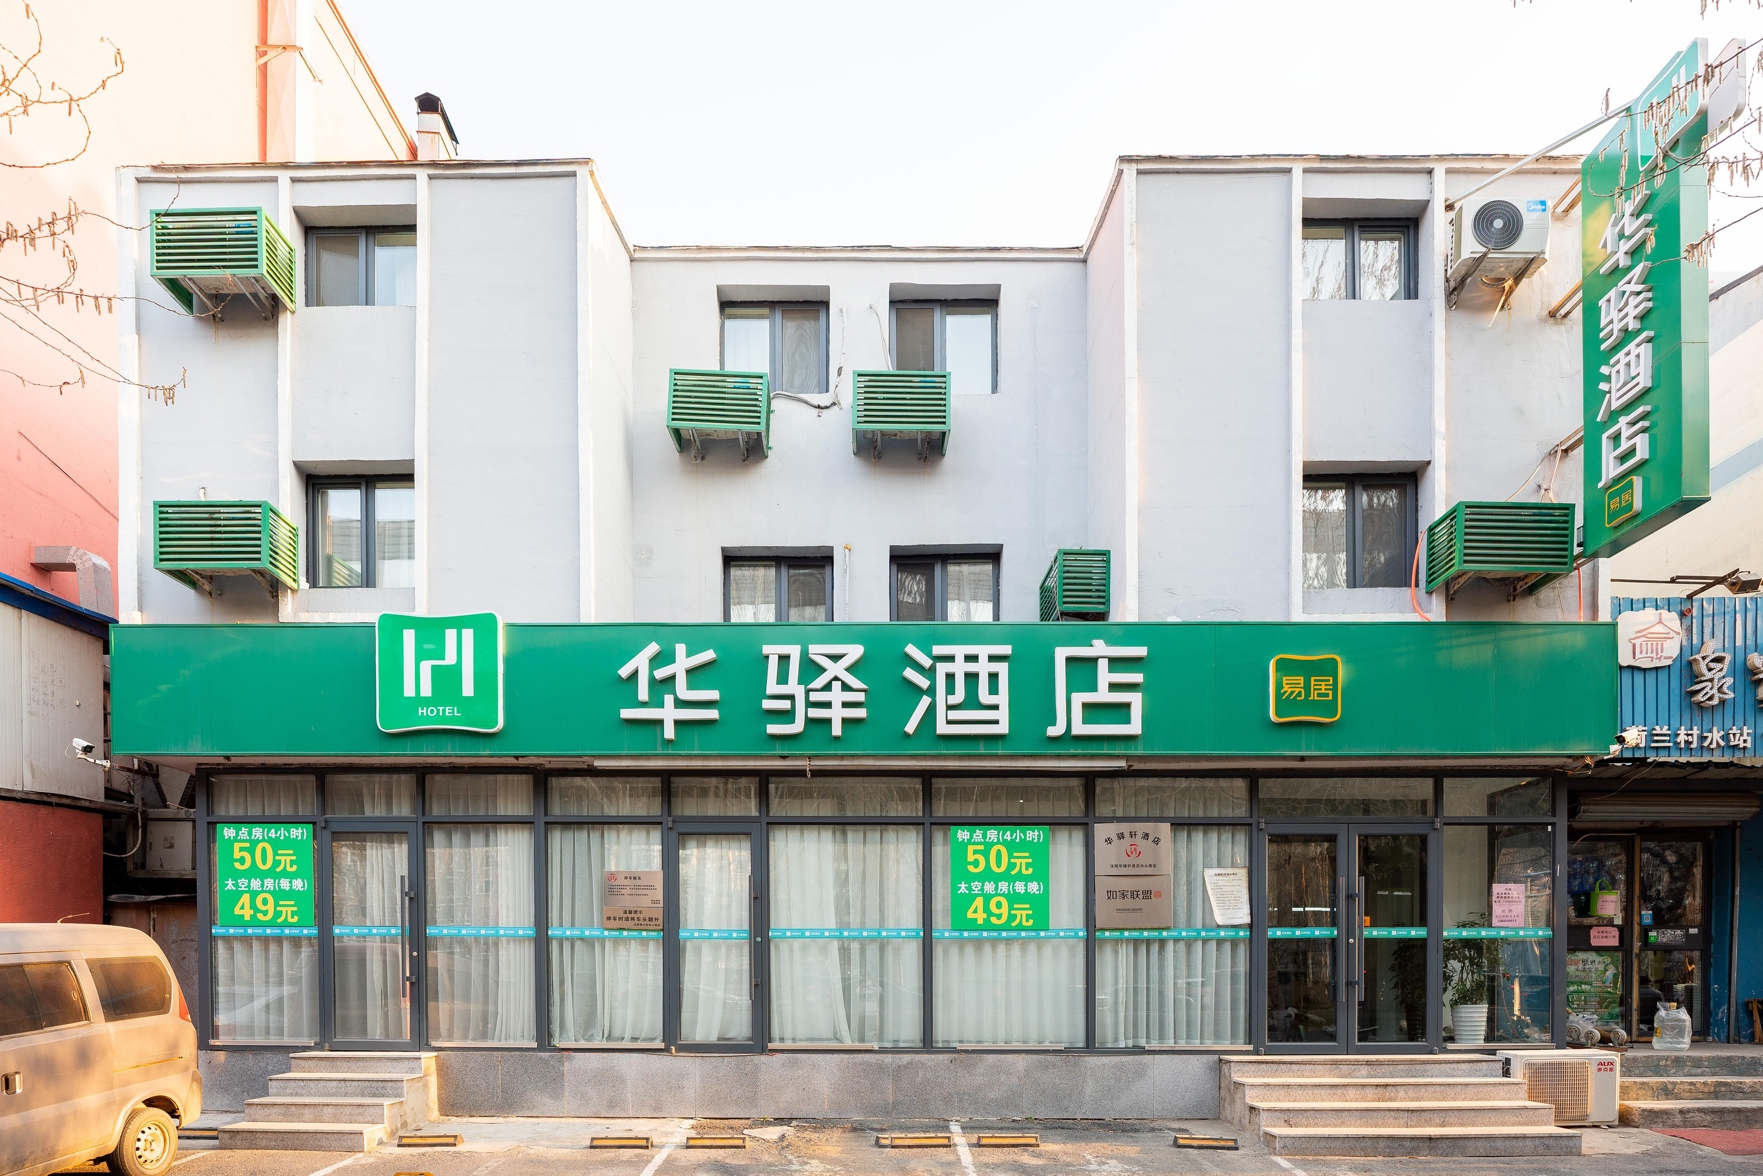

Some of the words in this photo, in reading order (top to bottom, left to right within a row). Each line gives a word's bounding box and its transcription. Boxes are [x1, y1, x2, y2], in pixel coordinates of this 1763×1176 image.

[1597, 190, 1653, 489] 华驿酒店
[617, 640, 1148, 741] 华驿酒店
[1280, 676, 1333, 700] 易居
[418, 706, 462, 717] HOTEL
[223, 827, 307, 840] 钟点房(4小时)
[957, 829, 1044, 842] 钟点房(4小时)
[233, 841, 298, 872] 50元
[966, 844, 1033, 875] 50元
[224, 878, 308, 891] 太空舱房(每晚)
[957, 881, 1044, 894] 太空舱房(每晚)
[1106, 889, 1153, 900] 如家联盟
[233, 893, 299, 923] 49元
[966, 896, 1034, 927] 49元
